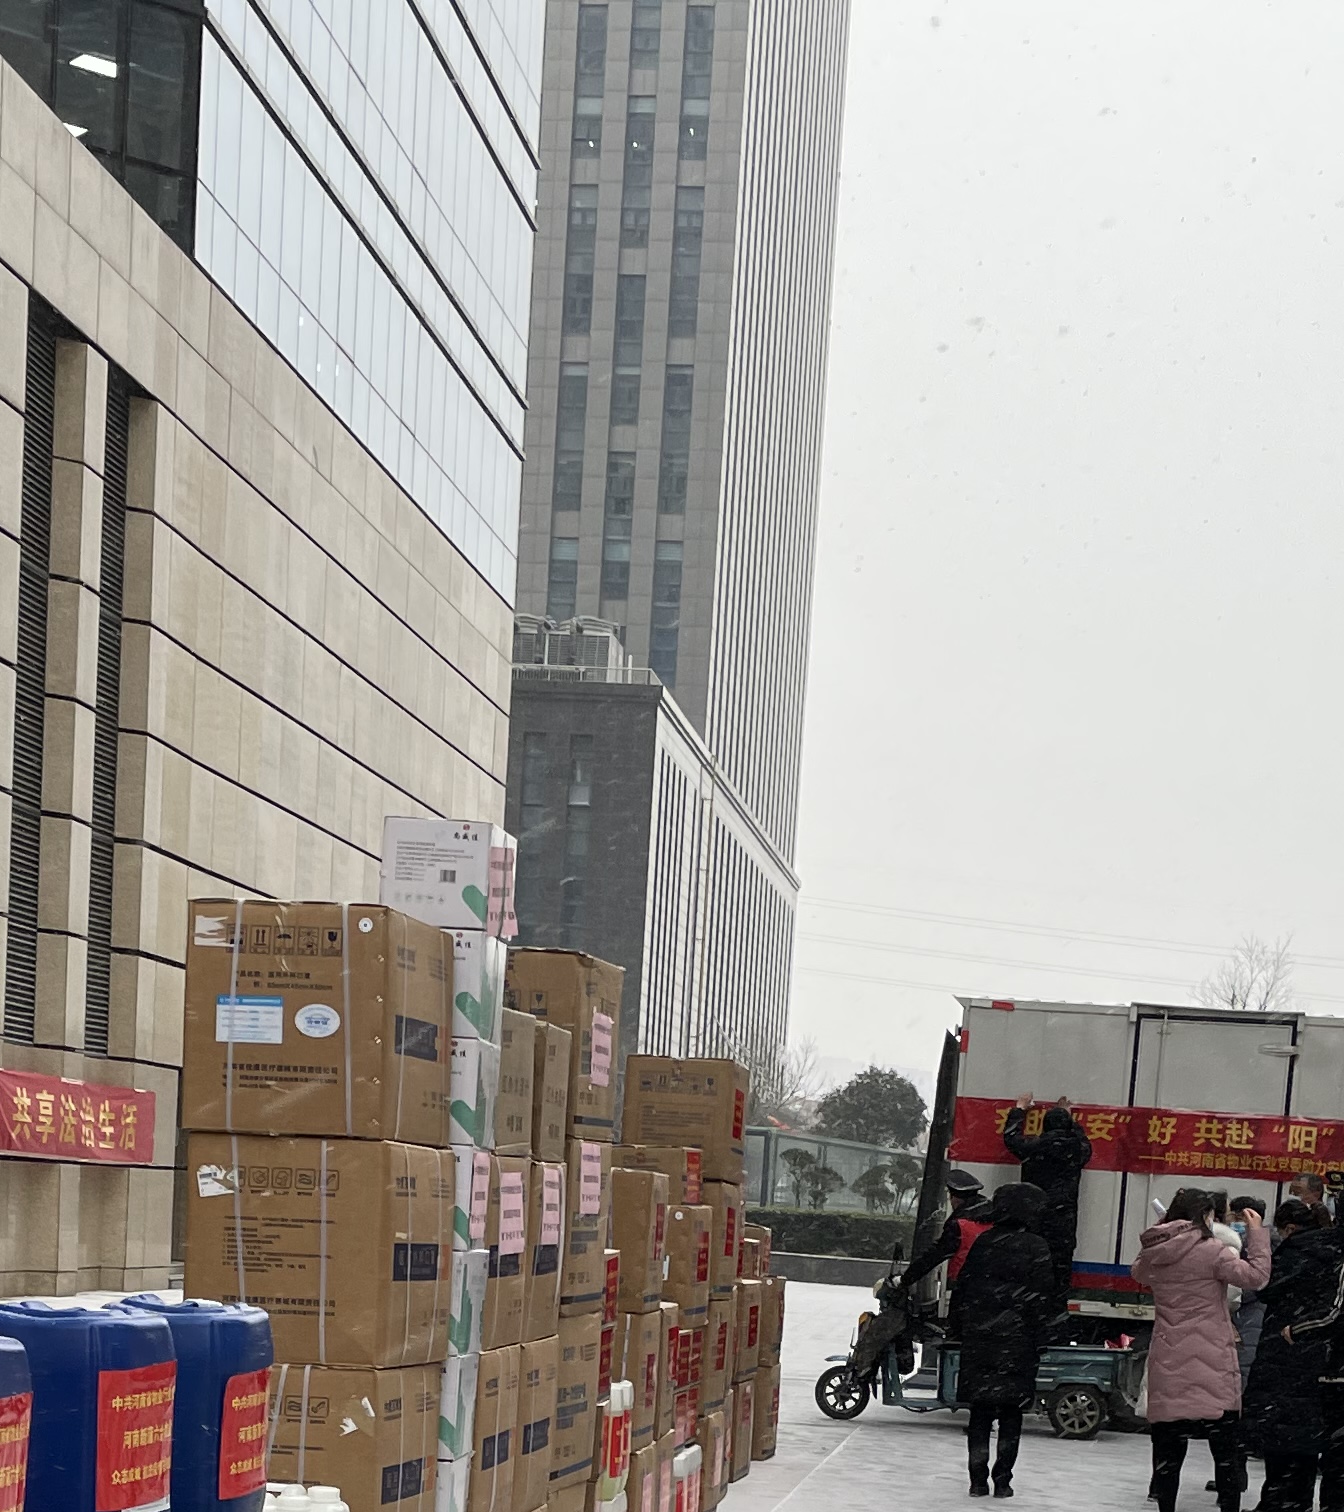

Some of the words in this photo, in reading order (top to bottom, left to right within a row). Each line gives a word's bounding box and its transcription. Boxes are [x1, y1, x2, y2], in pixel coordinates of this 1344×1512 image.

[12, 1086, 138, 1151] 共享法治生活
